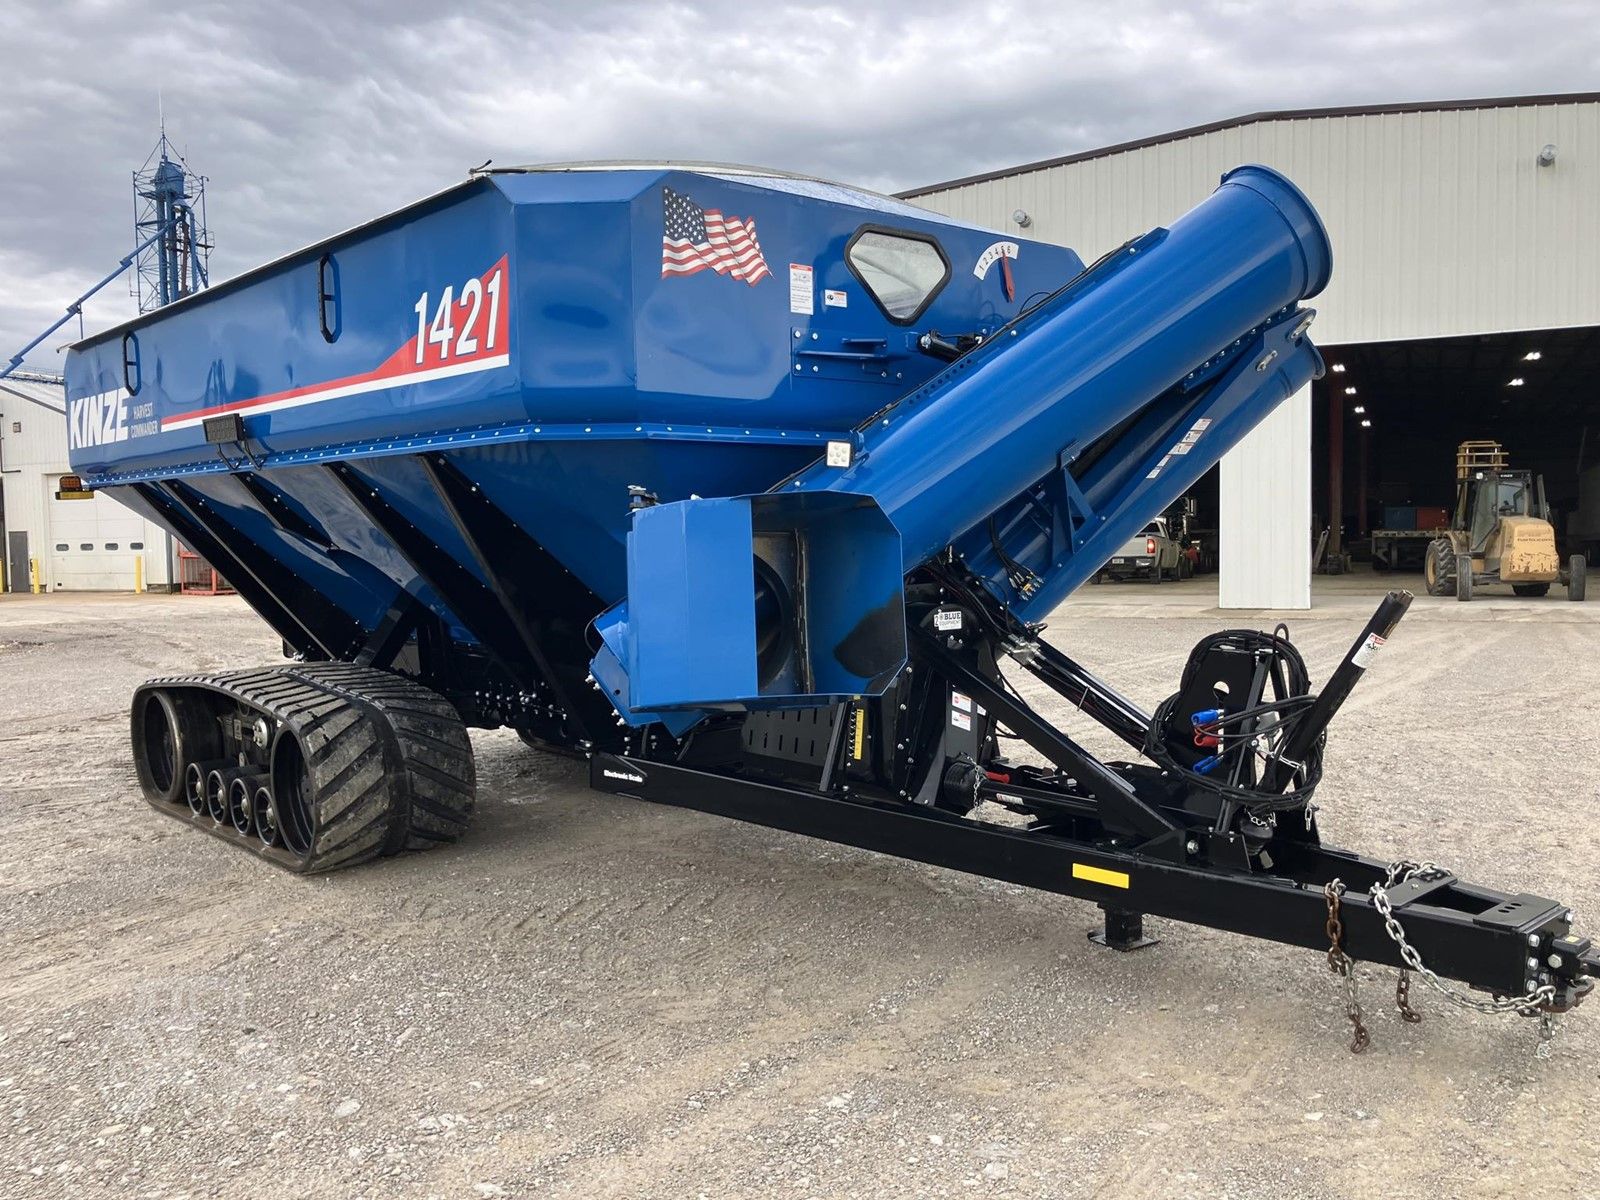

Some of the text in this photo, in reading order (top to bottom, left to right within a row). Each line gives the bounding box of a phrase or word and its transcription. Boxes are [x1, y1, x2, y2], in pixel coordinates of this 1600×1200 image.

[414, 268, 502, 364] 1421
[70, 386, 130, 450] KINZE
[132, 402, 154, 420] HARVEST
[130, 421, 159, 438] COMMANDER
[944, 612, 961, 620] BLUE
[603, 769, 643, 783] Electronic Scale
